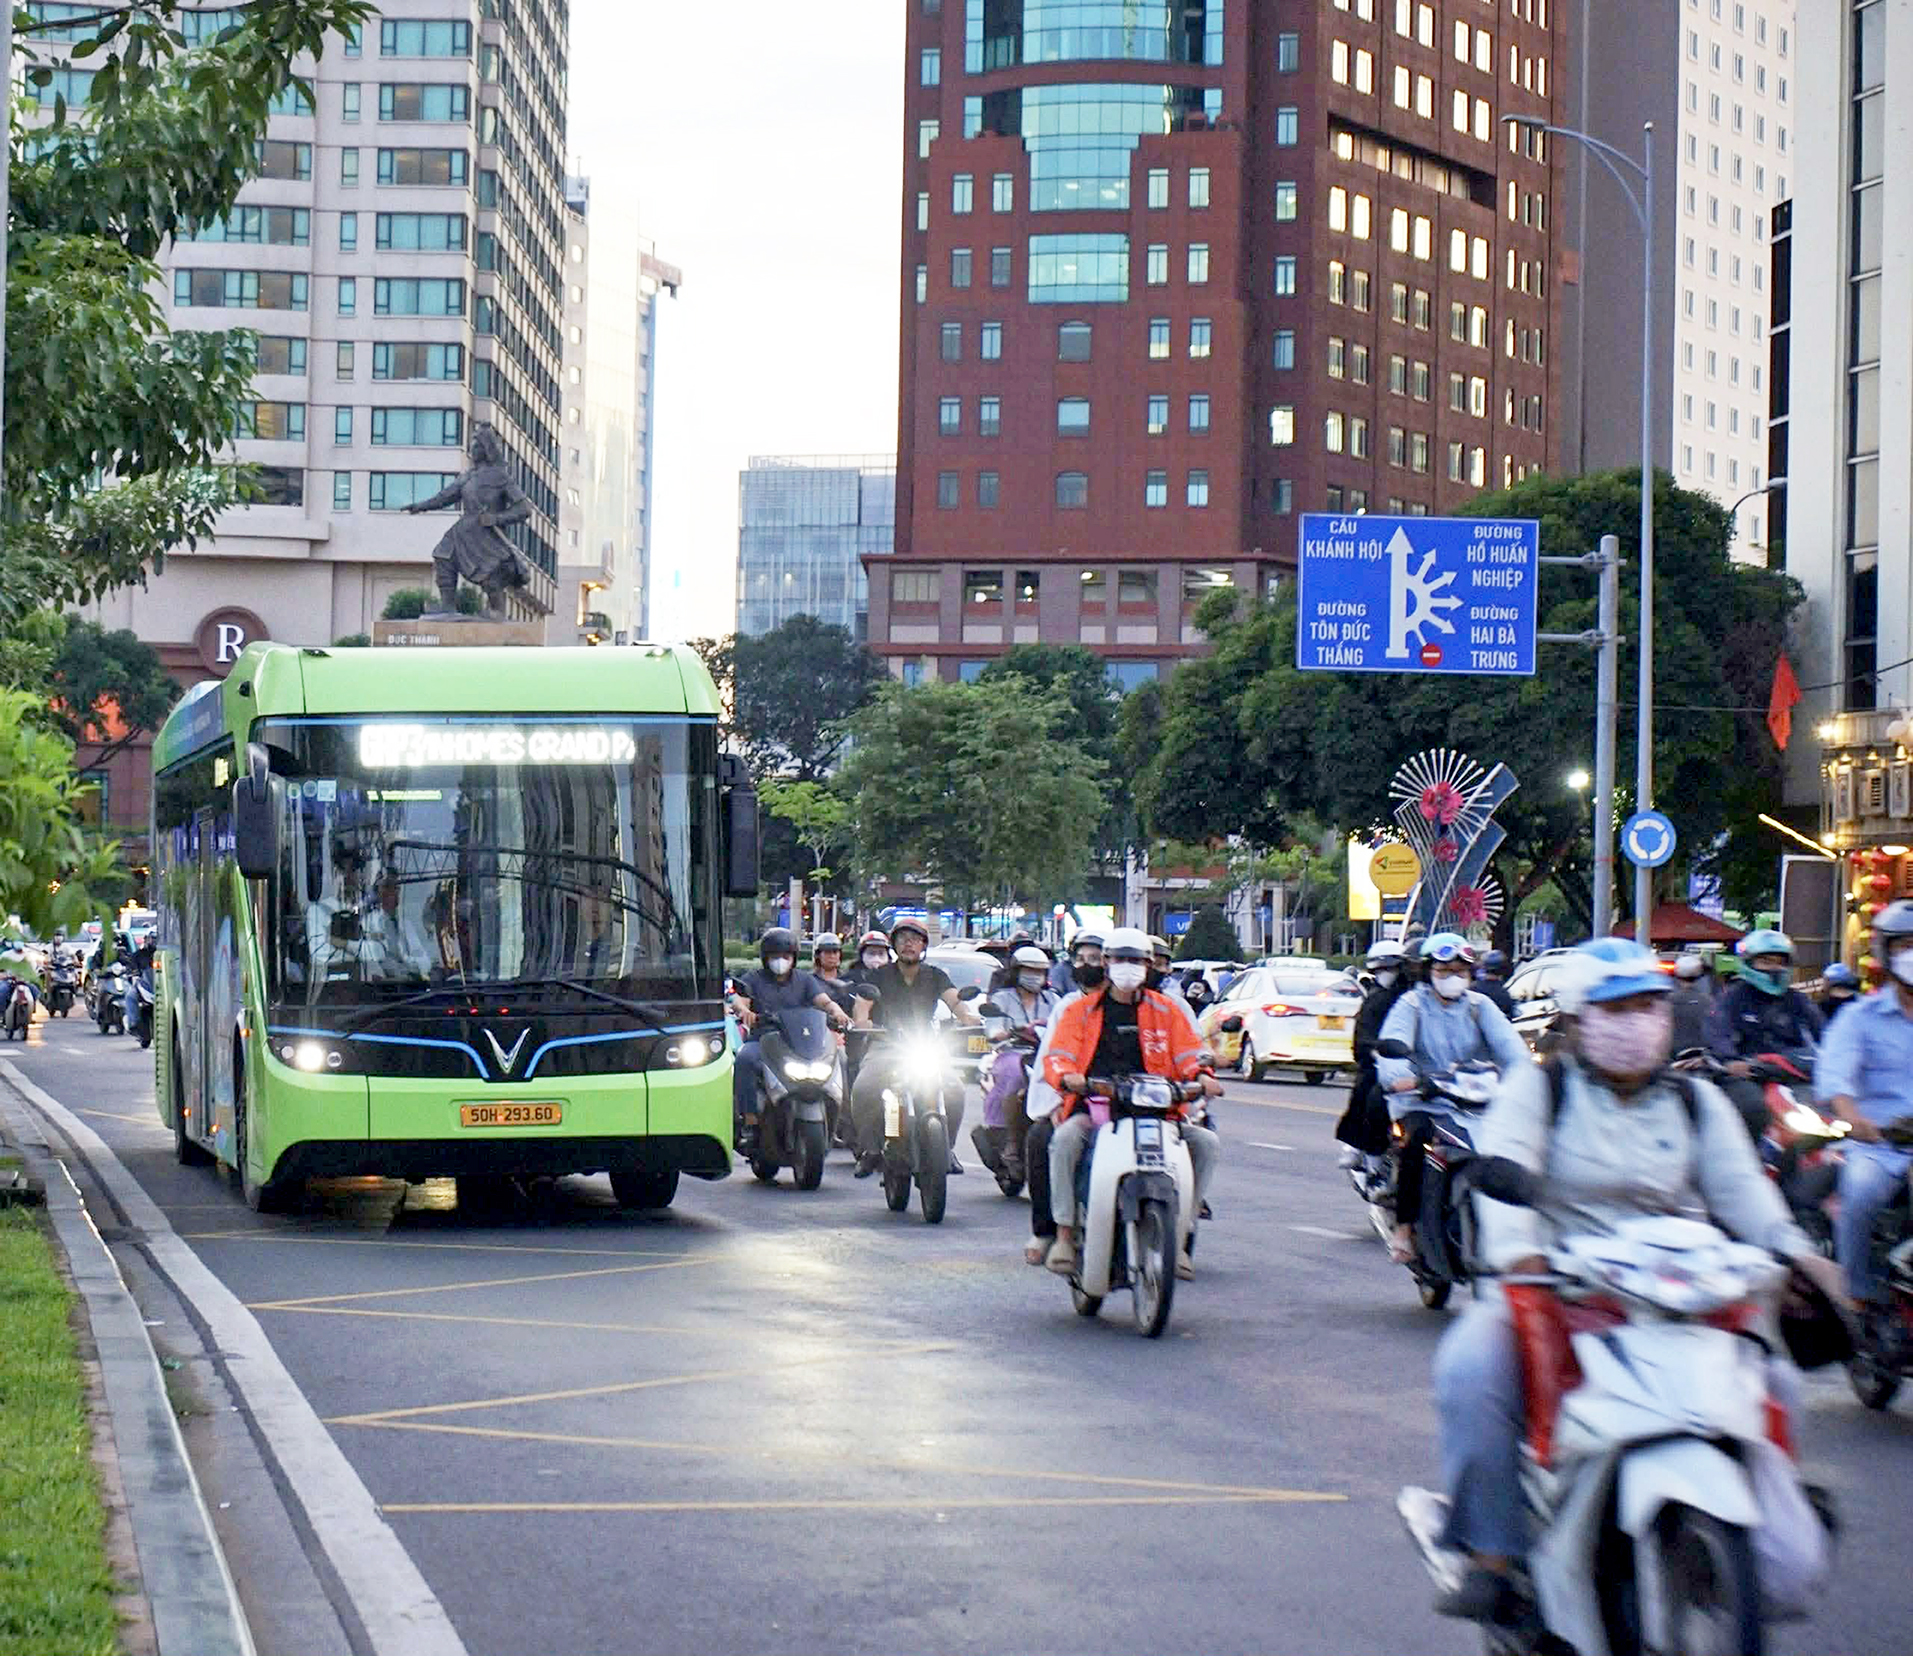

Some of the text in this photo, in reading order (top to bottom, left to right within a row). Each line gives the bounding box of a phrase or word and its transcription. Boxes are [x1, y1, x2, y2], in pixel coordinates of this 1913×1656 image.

[1473, 523, 1523, 540] ĐƯỜNG
[1306, 536, 1383, 563] KHÁNH HỘI
[1490, 541, 1528, 564] HUẤN
[1472, 567, 1524, 591] NGHIỆP
[1317, 600, 1367, 617] ĐƯỜNG
[1470, 604, 1519, 621] ĐƯỜNG
[1309, 618, 1371, 642] TÔN ĐỨC
[1470, 623, 1517, 646] HAI BÀ
[216, 624, 245, 662] R
[1316, 641, 1364, 666] THẮNG
[1470, 650, 1519, 670] TRƯNG
[528, 731, 610, 761] GRAND
